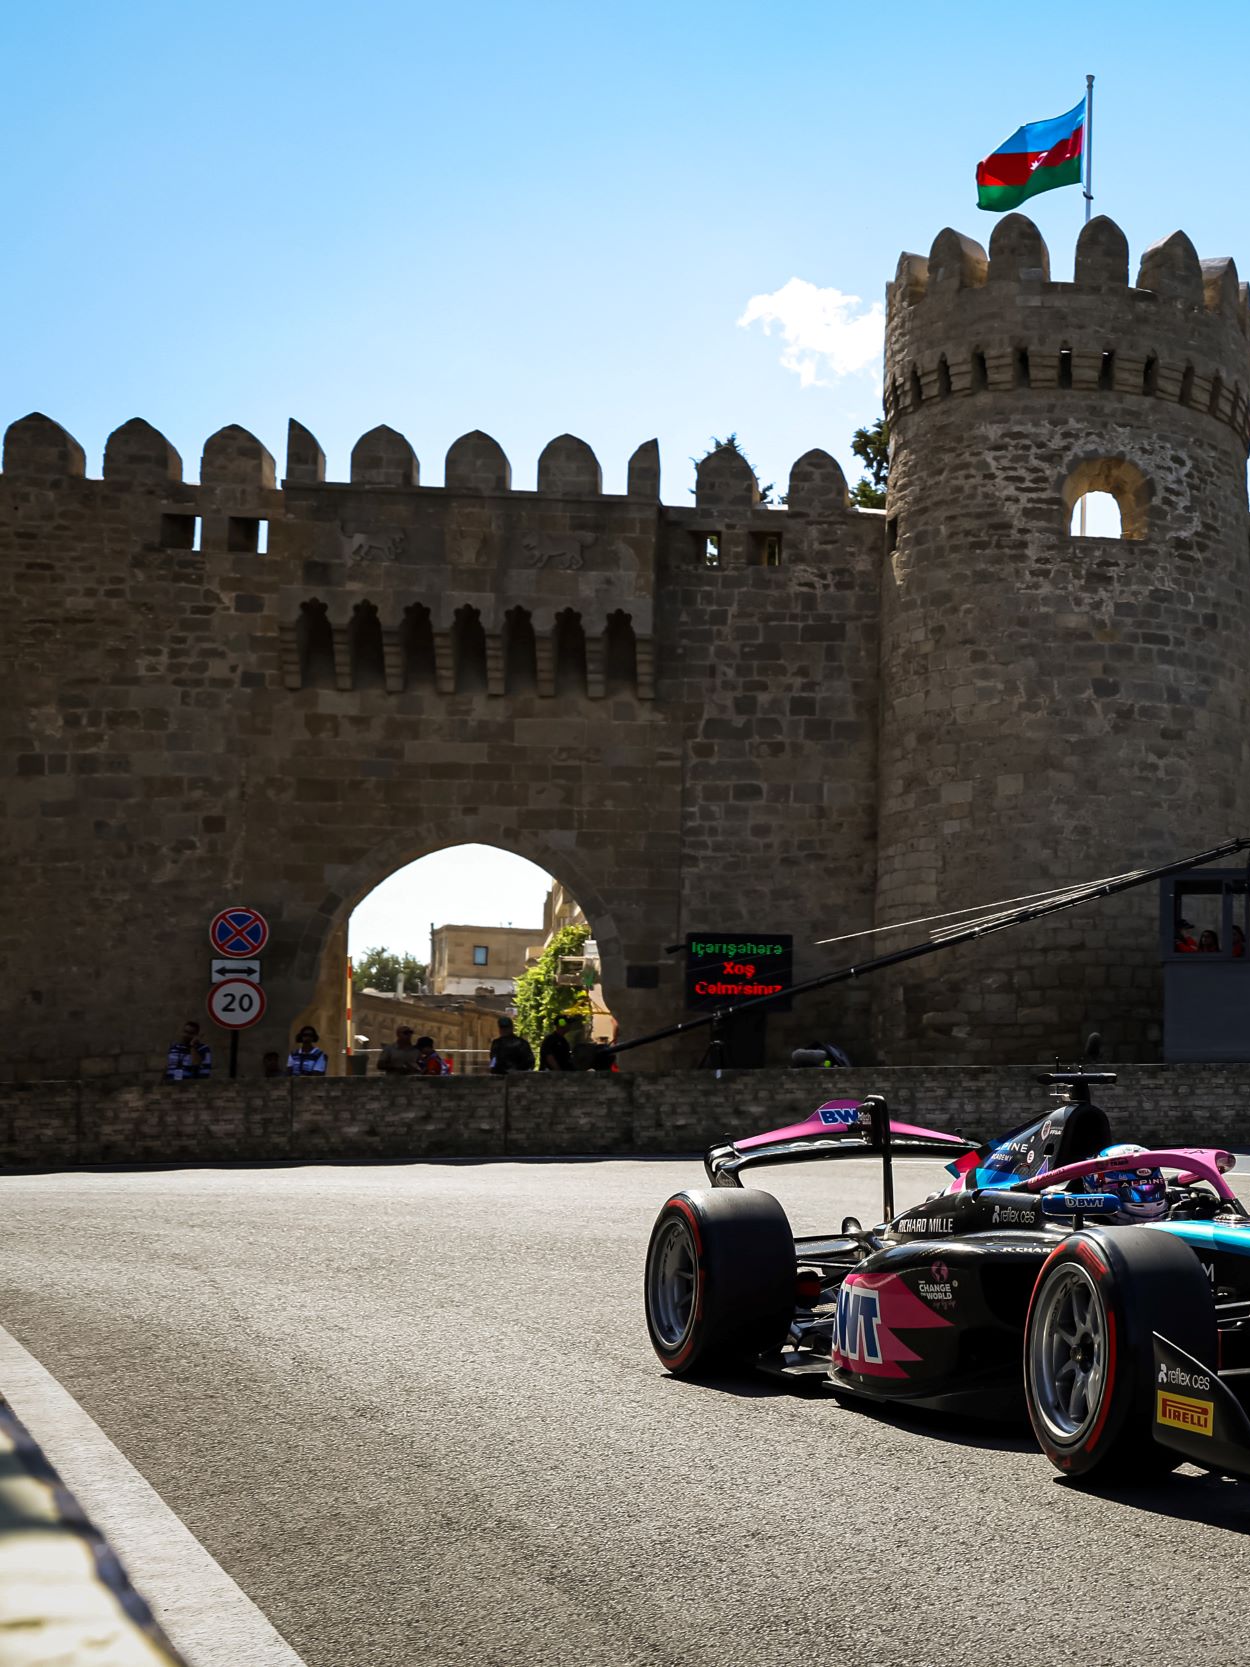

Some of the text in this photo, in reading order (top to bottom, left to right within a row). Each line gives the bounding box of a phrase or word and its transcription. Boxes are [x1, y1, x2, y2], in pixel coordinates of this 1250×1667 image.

[723, 961, 756, 979] Xoş
[222, 993, 253, 1012] 20
[819, 1108, 858, 1125] BW
[1077, 1196, 1104, 1207] BWT
[1000, 1207, 1035, 1224] reflex ces
[898, 1218, 954, 1233] RICHARD MILLE
[919, 1283, 951, 1292] CHANGE
[927, 1292, 952, 1300] WORLD
[1168, 1368, 1210, 1390] reflex ces
[1161, 1397, 1209, 1429] PIRELLI
